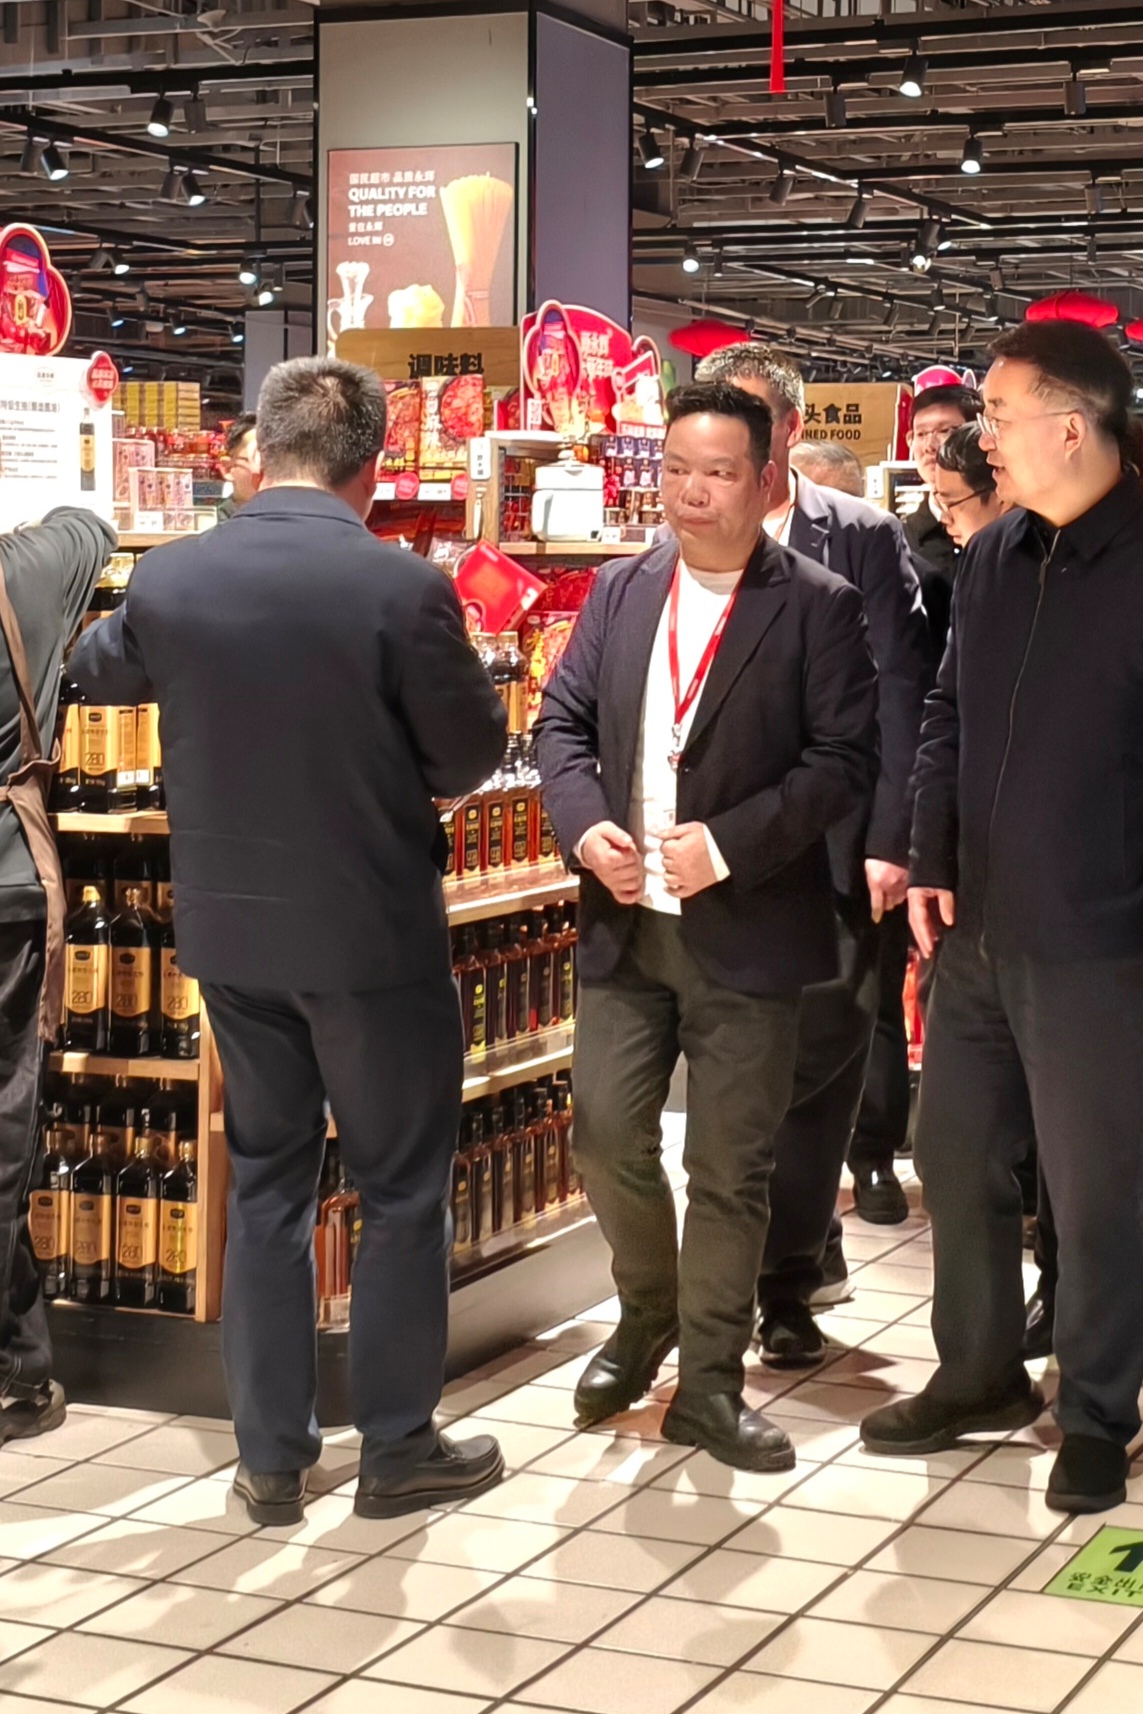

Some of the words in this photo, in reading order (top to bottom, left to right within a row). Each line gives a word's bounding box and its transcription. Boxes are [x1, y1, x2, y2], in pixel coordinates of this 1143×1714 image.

[348, 186, 407, 203] QUALITY
[408, 184, 436, 199] FOR
[347, 204, 375, 218] THE
[376, 202, 428, 217] PEOPLE
[347, 236, 371, 246] LOVE
[407, 352, 485, 380] 调味料
[830, 428, 862, 441] FOOD
